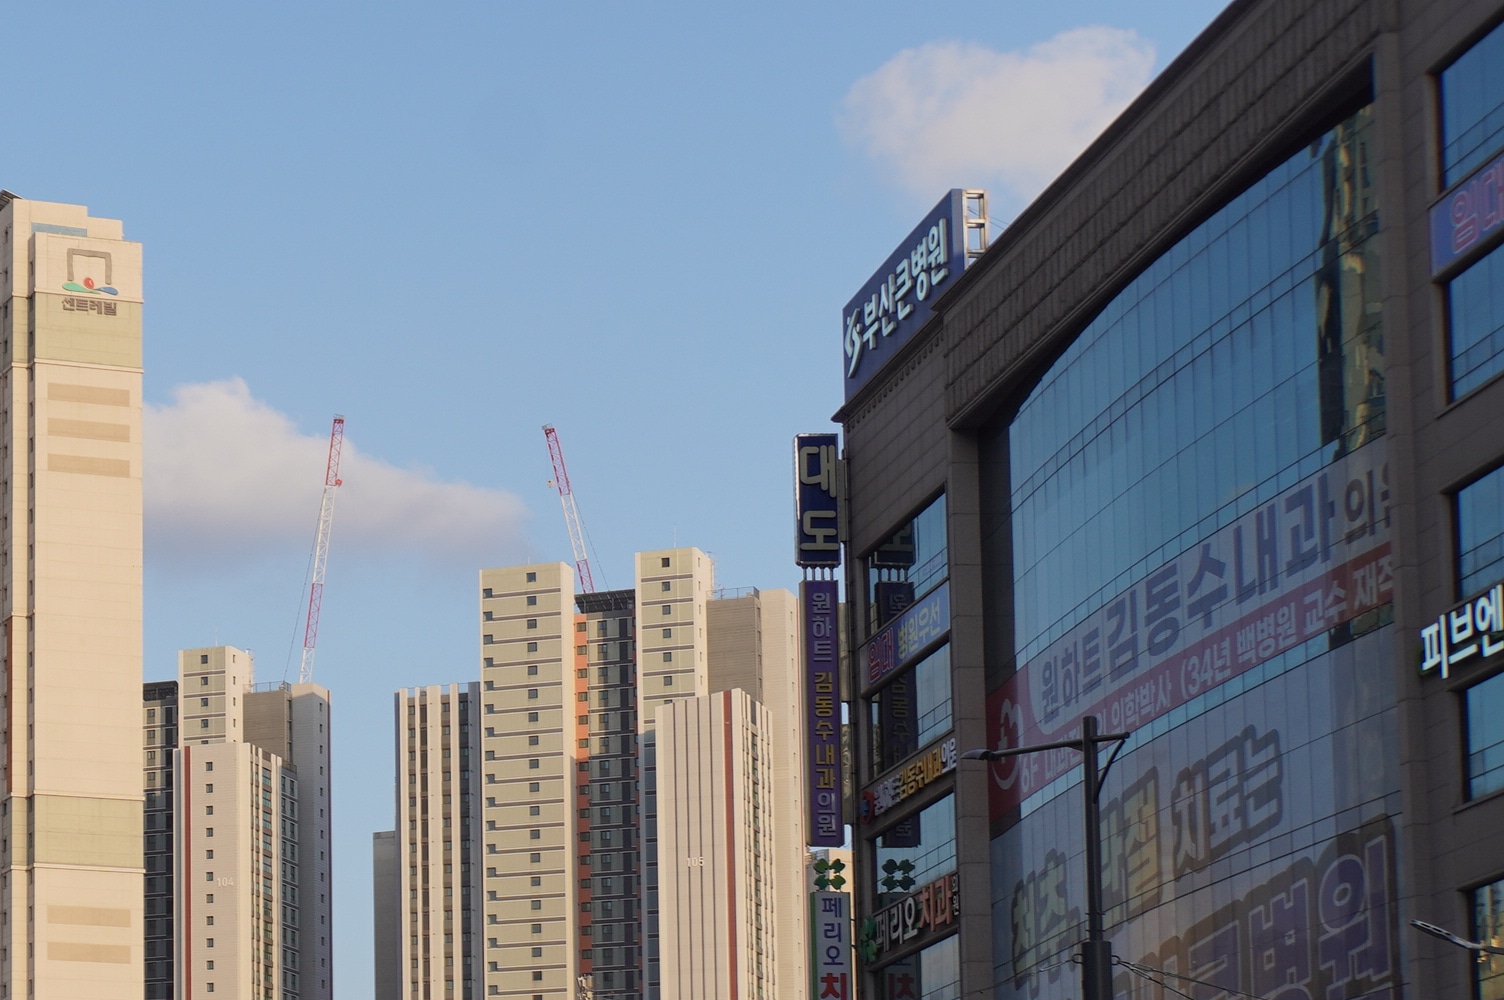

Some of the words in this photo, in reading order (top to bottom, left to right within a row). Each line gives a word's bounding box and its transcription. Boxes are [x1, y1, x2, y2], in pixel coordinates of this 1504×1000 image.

[61, 298, 117, 316] 센트레빌
[862, 216, 947, 351] 부산큰병원
[799, 444, 838, 551] 대도
[1302, 578, 1348, 635] 교수
[868, 627, 894, 683] 임대
